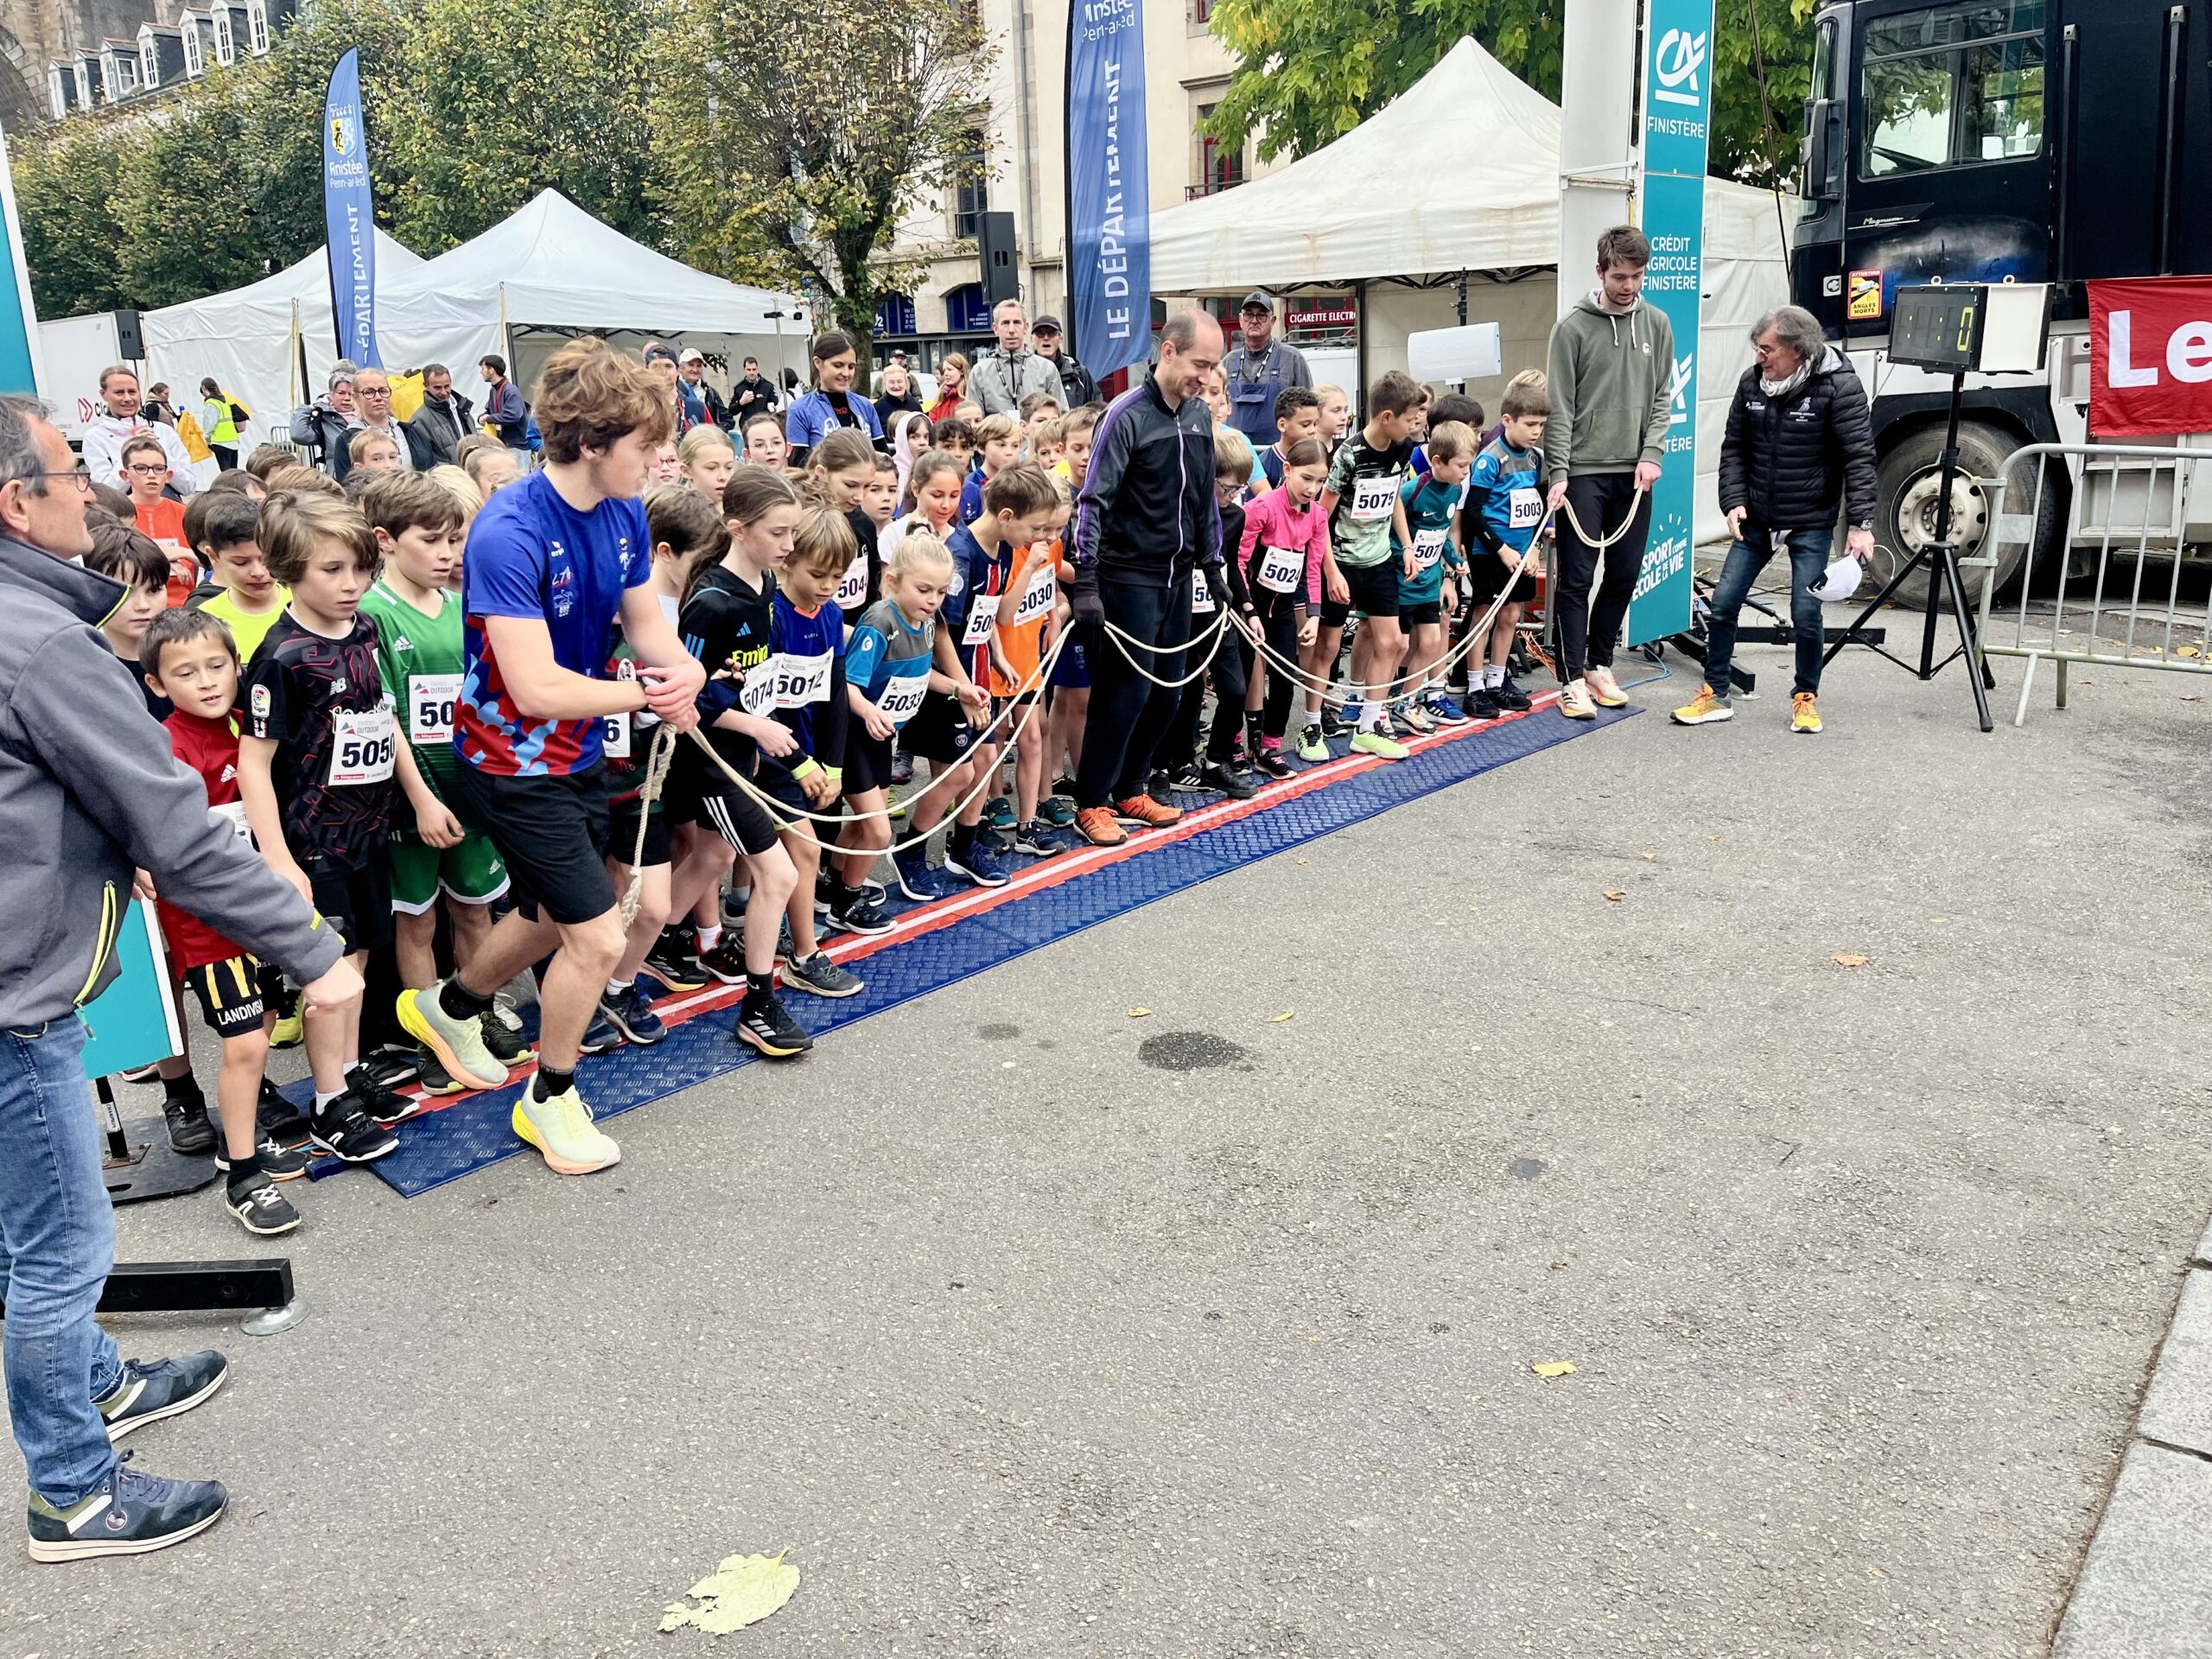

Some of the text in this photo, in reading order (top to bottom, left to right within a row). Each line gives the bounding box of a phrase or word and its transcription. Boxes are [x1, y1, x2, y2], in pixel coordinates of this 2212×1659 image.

[1647, 116, 1705, 139] FINISTÈRE
[1863, 217, 1904, 227] Magnum
[1650, 233, 1691, 252] CRÉDIT
[1645, 256, 1697, 271] AGRICOLE
[346, 203, 372, 364] ÉPARTEMENT
[1642, 271, 1697, 291] FINISTÈRE
[1106, 307, 1130, 339] LE
[1289, 312, 1326, 324] CIGARETTE
[1357, 492, 1395, 509] 5075
[1515, 502, 1541, 518] 5003
[1642, 537, 1674, 575] SPORT
[1662, 570, 1669, 582] LA
[1669, 550, 1684, 575] VIE
[1018, 582, 1052, 613] 5030
[776, 670, 825, 696] 5012
[744, 677, 775, 713] 5074
[881, 690, 925, 712] 5033
[356, 725, 379, 734] OUTDOOR
[341, 732, 396, 768] 5050
